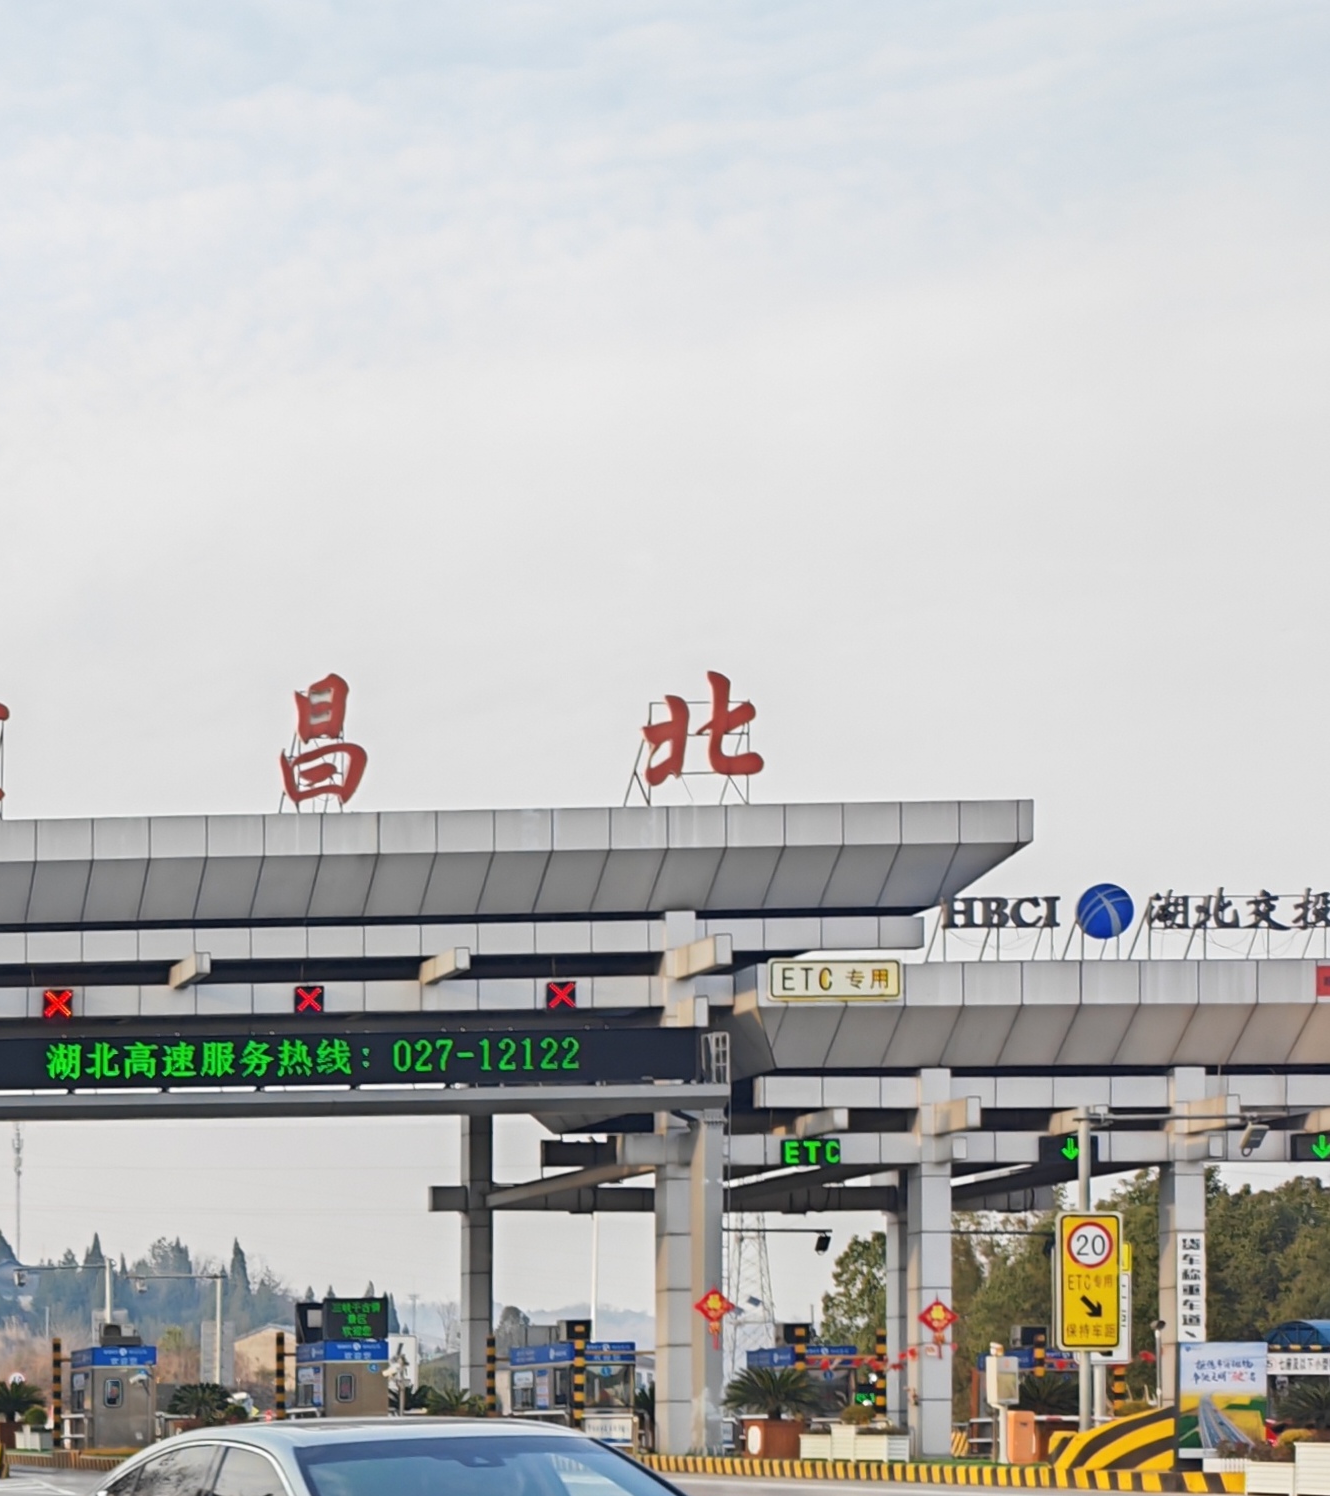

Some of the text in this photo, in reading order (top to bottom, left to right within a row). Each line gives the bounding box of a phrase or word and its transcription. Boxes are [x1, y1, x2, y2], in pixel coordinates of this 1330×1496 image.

[943, 896, 1060, 929] HBCI
[782, 967, 888, 991] ETC 专用
[785, 1140, 840, 1164] ETC
[1076, 1234, 1106, 1256] 20
[1068, 1274, 1090, 1290] ETC
[1066, 1323, 1116, 1339] 保持车距
